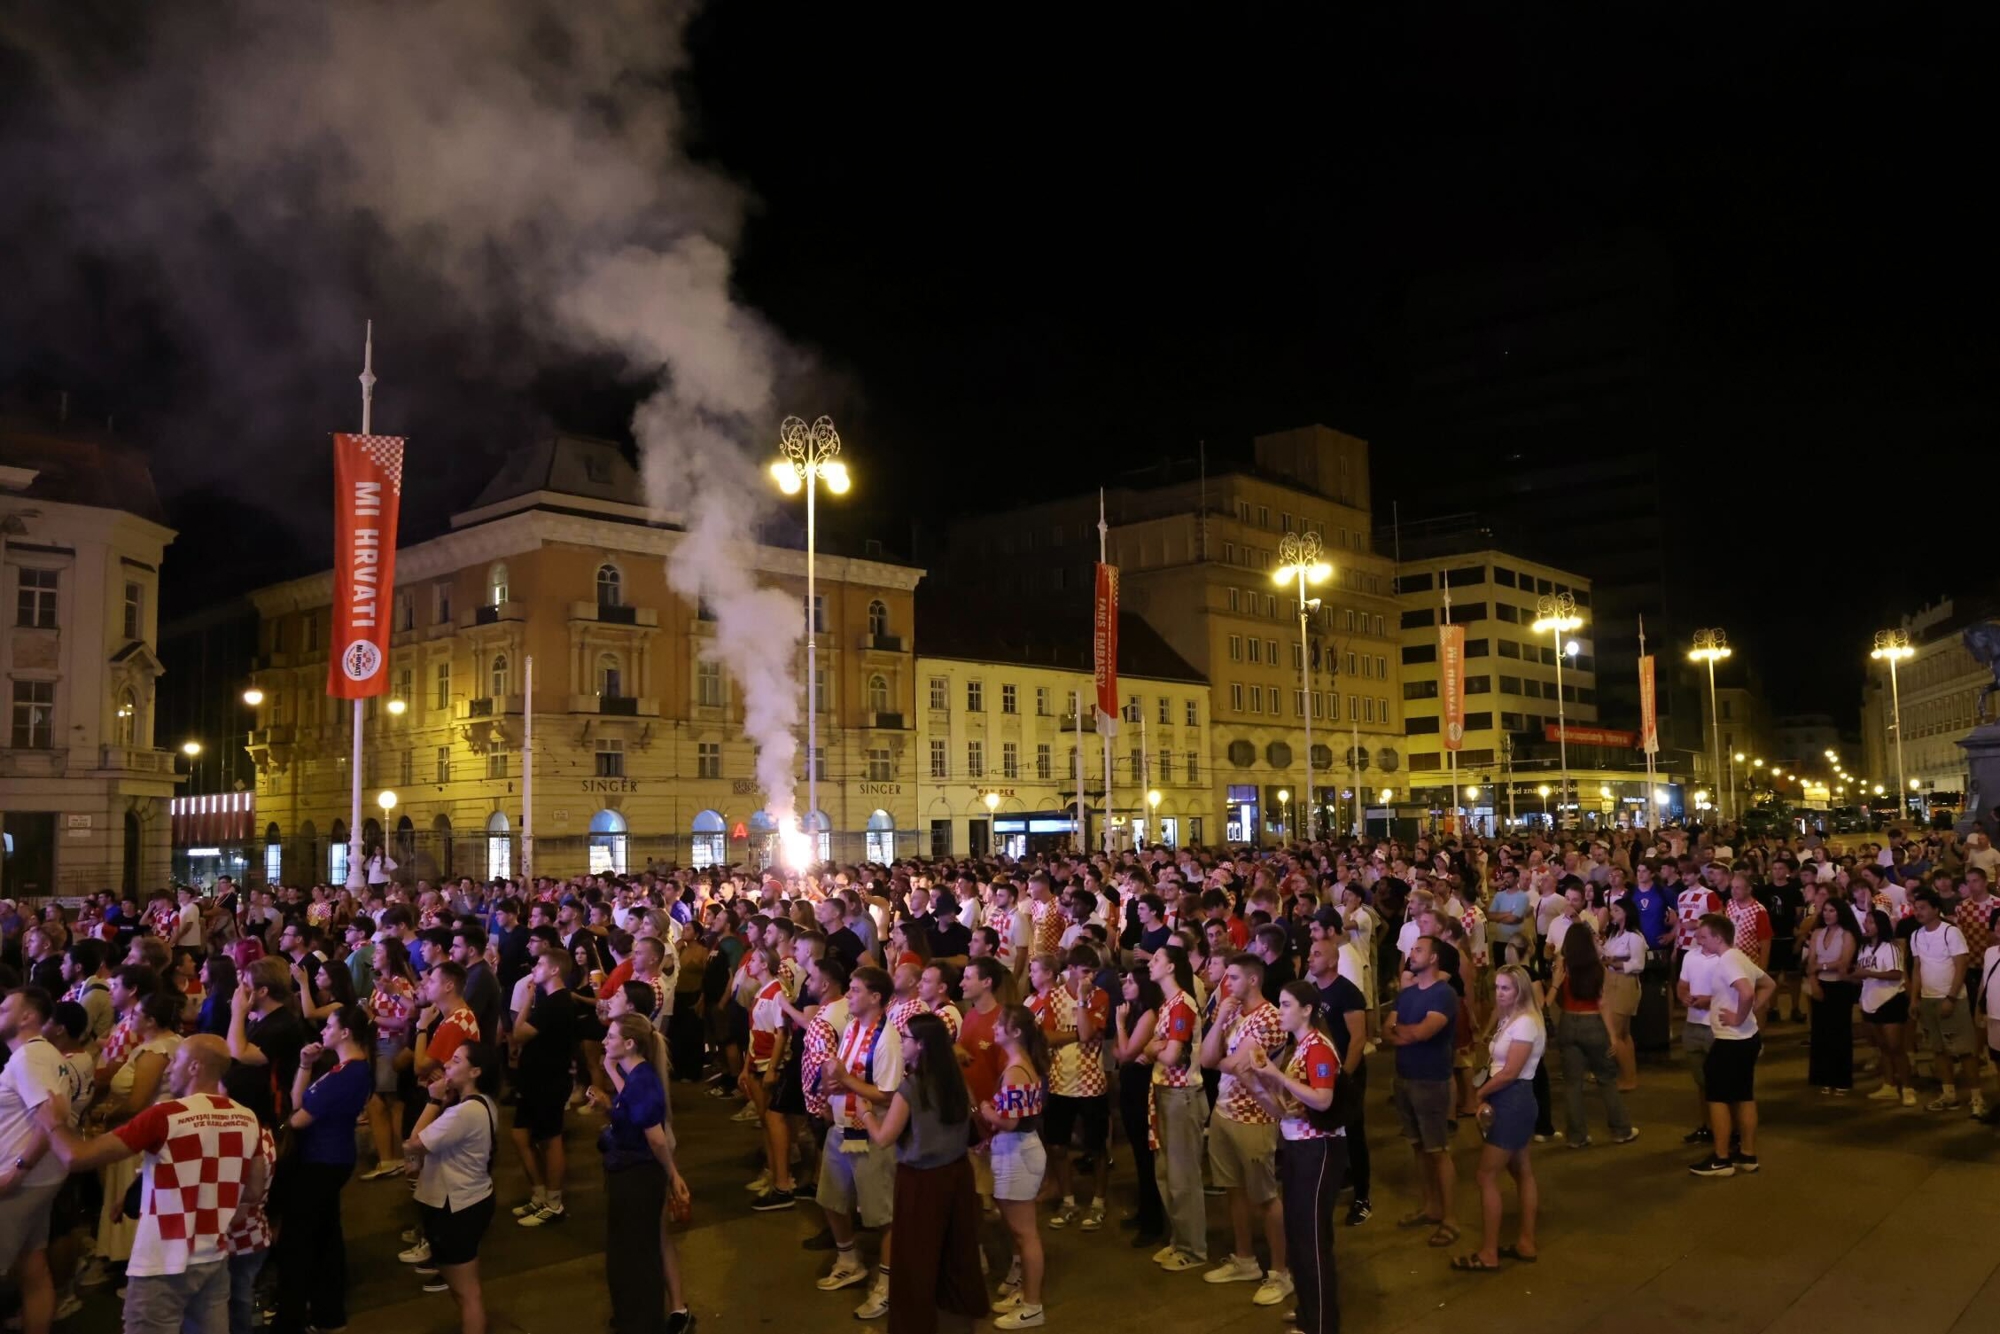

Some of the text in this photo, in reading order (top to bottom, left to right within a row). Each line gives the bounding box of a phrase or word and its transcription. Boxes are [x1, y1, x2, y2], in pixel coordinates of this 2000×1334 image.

[352, 481, 381, 627] MI HRVATI
[1095, 598, 1107, 688] FANS EMBASSY
[581, 780, 638, 792] SINGER
[860, 784, 902, 795] SINGER
